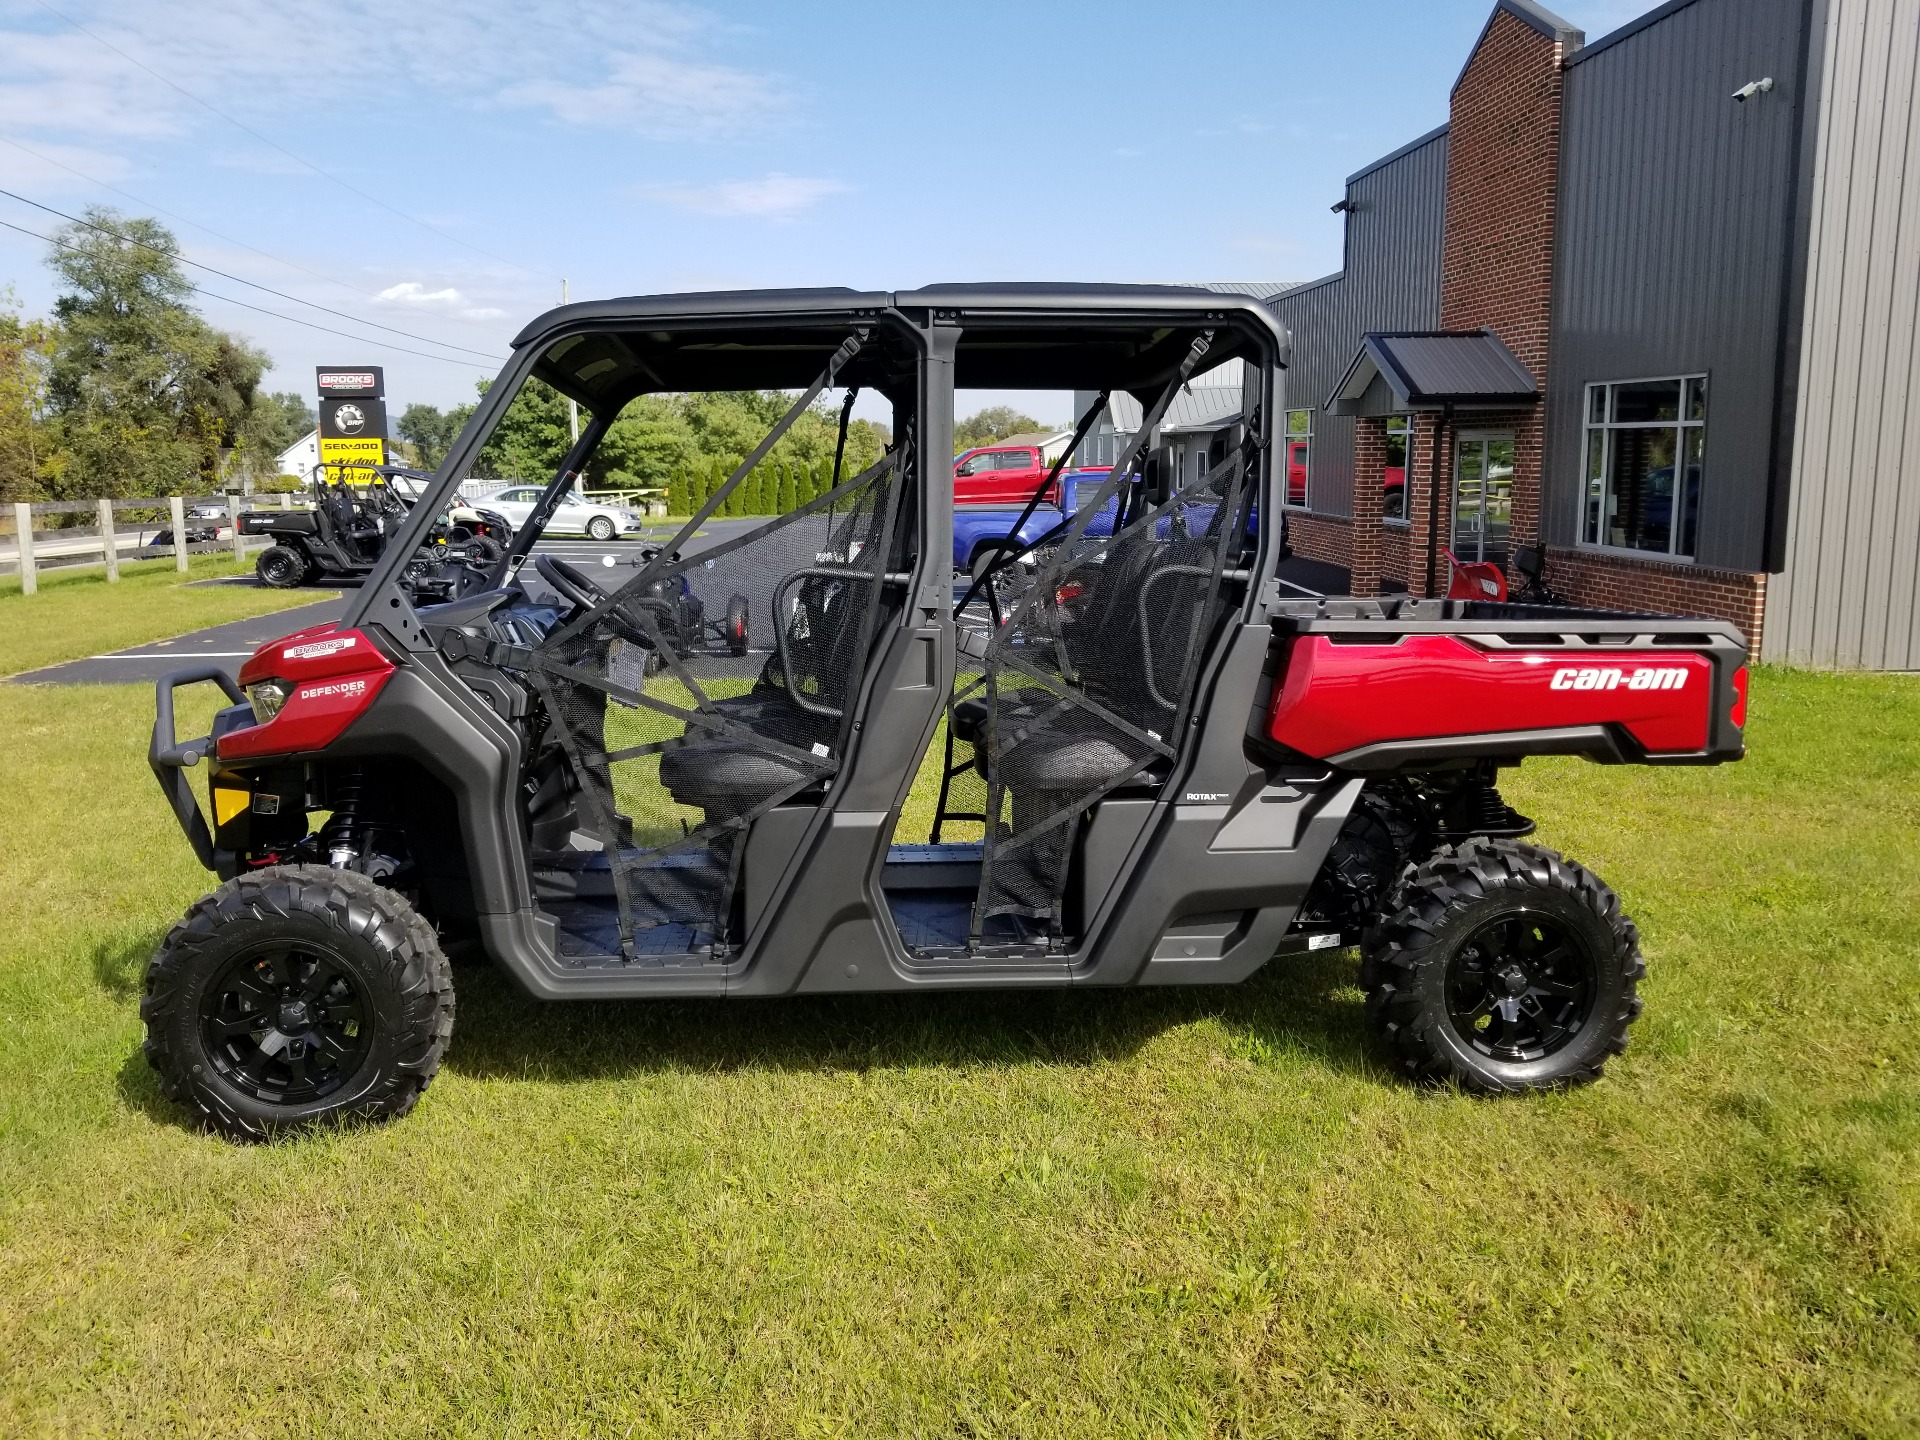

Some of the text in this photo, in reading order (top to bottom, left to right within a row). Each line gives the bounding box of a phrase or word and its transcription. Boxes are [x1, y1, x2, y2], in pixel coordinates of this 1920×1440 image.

[322, 375, 371, 384] BROOKS
[329, 472, 374, 480] cn-a
[1550, 668, 1689, 690] can-am
[301, 680, 365, 699] DEFENDER
[343, 688, 365, 698] XT
[1186, 793, 1217, 801] ROTAX
